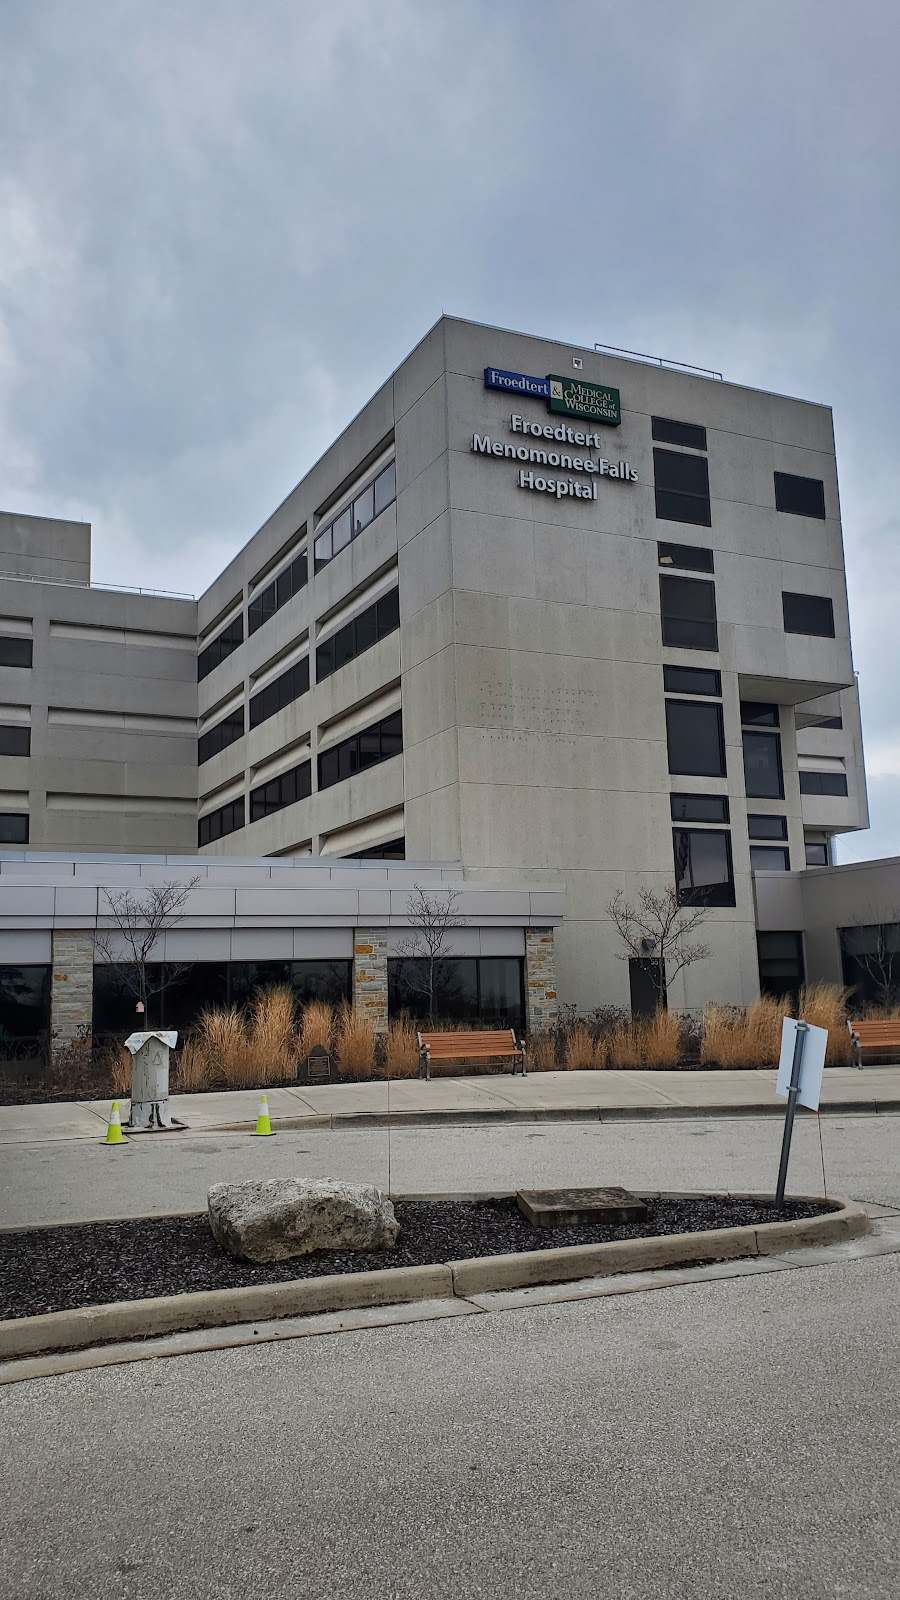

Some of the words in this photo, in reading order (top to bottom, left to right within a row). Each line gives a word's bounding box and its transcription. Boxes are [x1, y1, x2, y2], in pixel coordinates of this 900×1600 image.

[491, 371, 548, 394] Froedtert
[553, 386, 560, 397] &
[571, 383, 613, 402] MEDICAL
[564, 390, 608, 409] COLLEGE
[564, 398, 617, 418] WISCONSIN
[511, 414, 601, 448] Froedtert
[472, 433, 594, 473] Menomonee
[599, 458, 639, 482] Falls
[520, 470, 598, 500] Hospital
